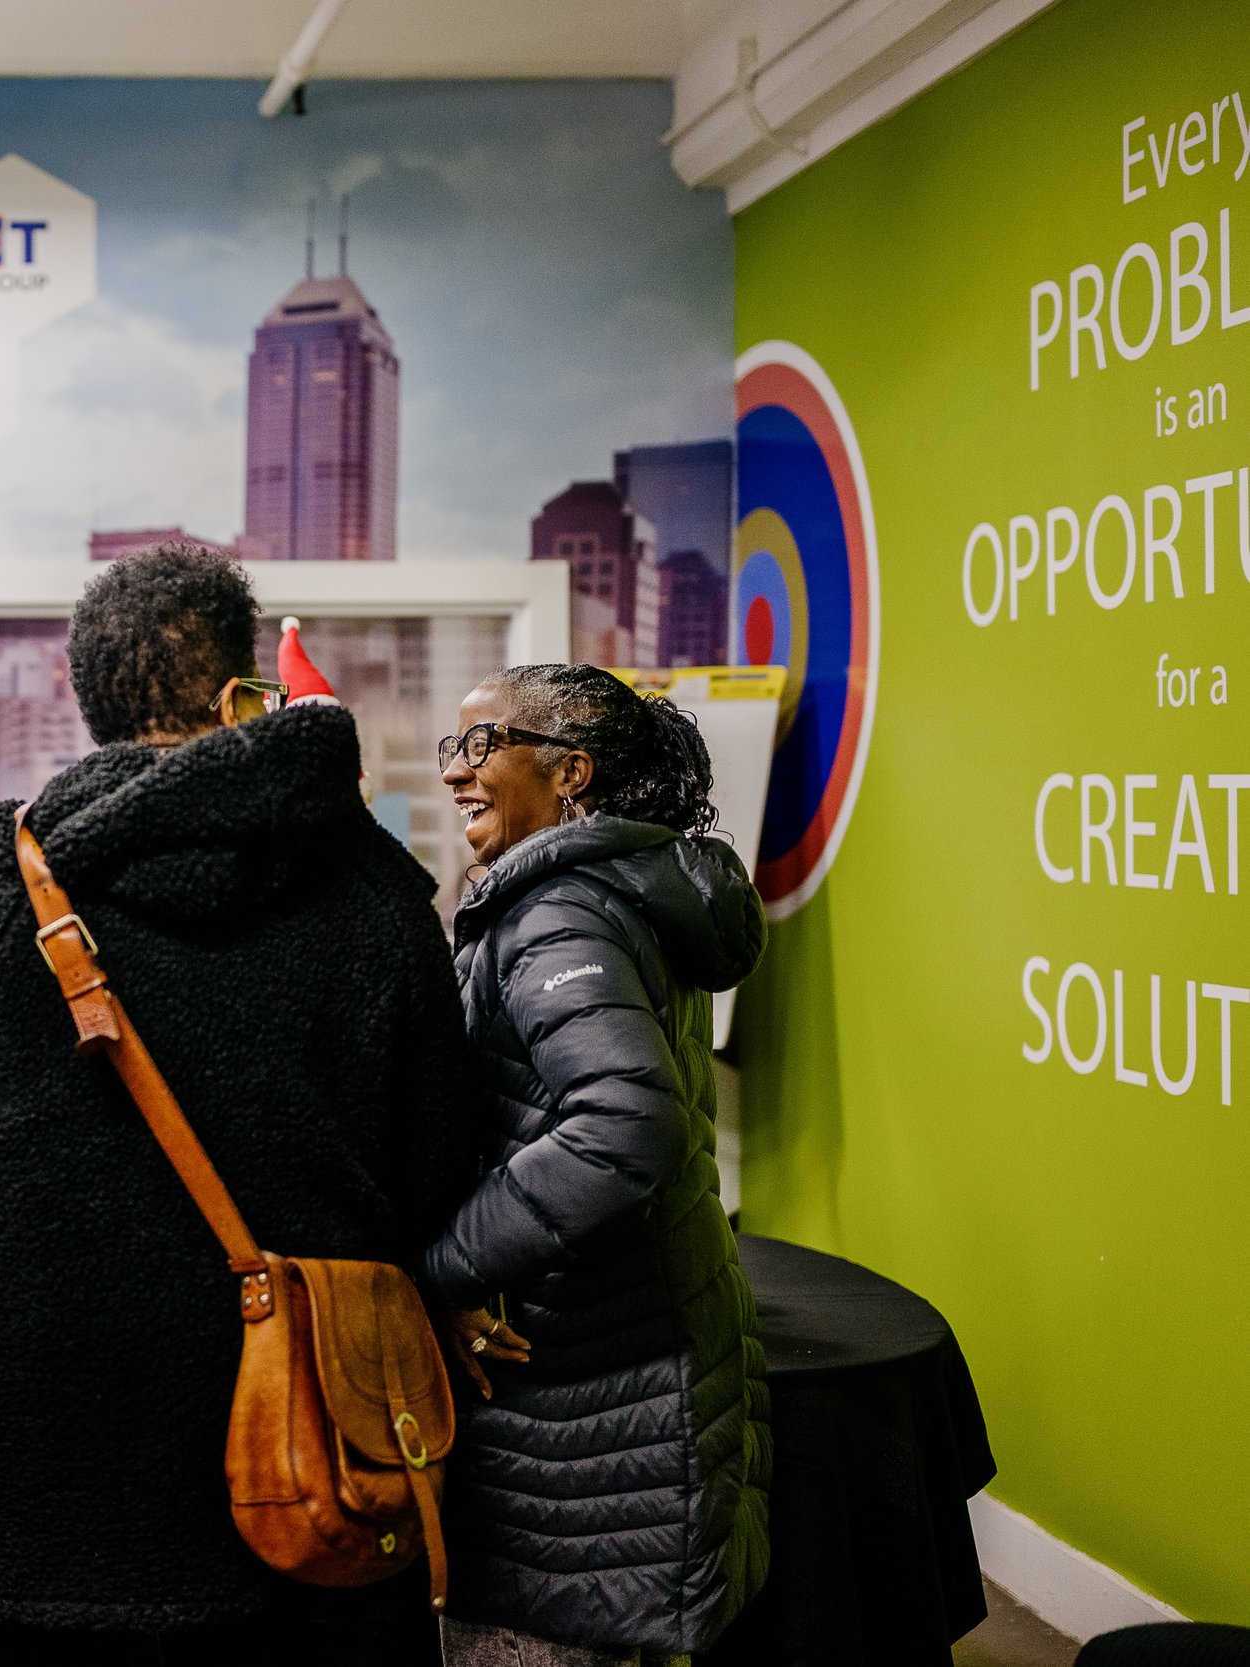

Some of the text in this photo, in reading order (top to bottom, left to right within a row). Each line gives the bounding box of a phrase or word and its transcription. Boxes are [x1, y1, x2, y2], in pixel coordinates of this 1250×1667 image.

[1123, 91, 1250, 205] Every
[1156, 382, 1228, 438] is an
[1156, 653, 1228, 708] for a
[1034, 772, 1250, 896] CREAT
[1021, 955, 1250, 1107] SOLUT
